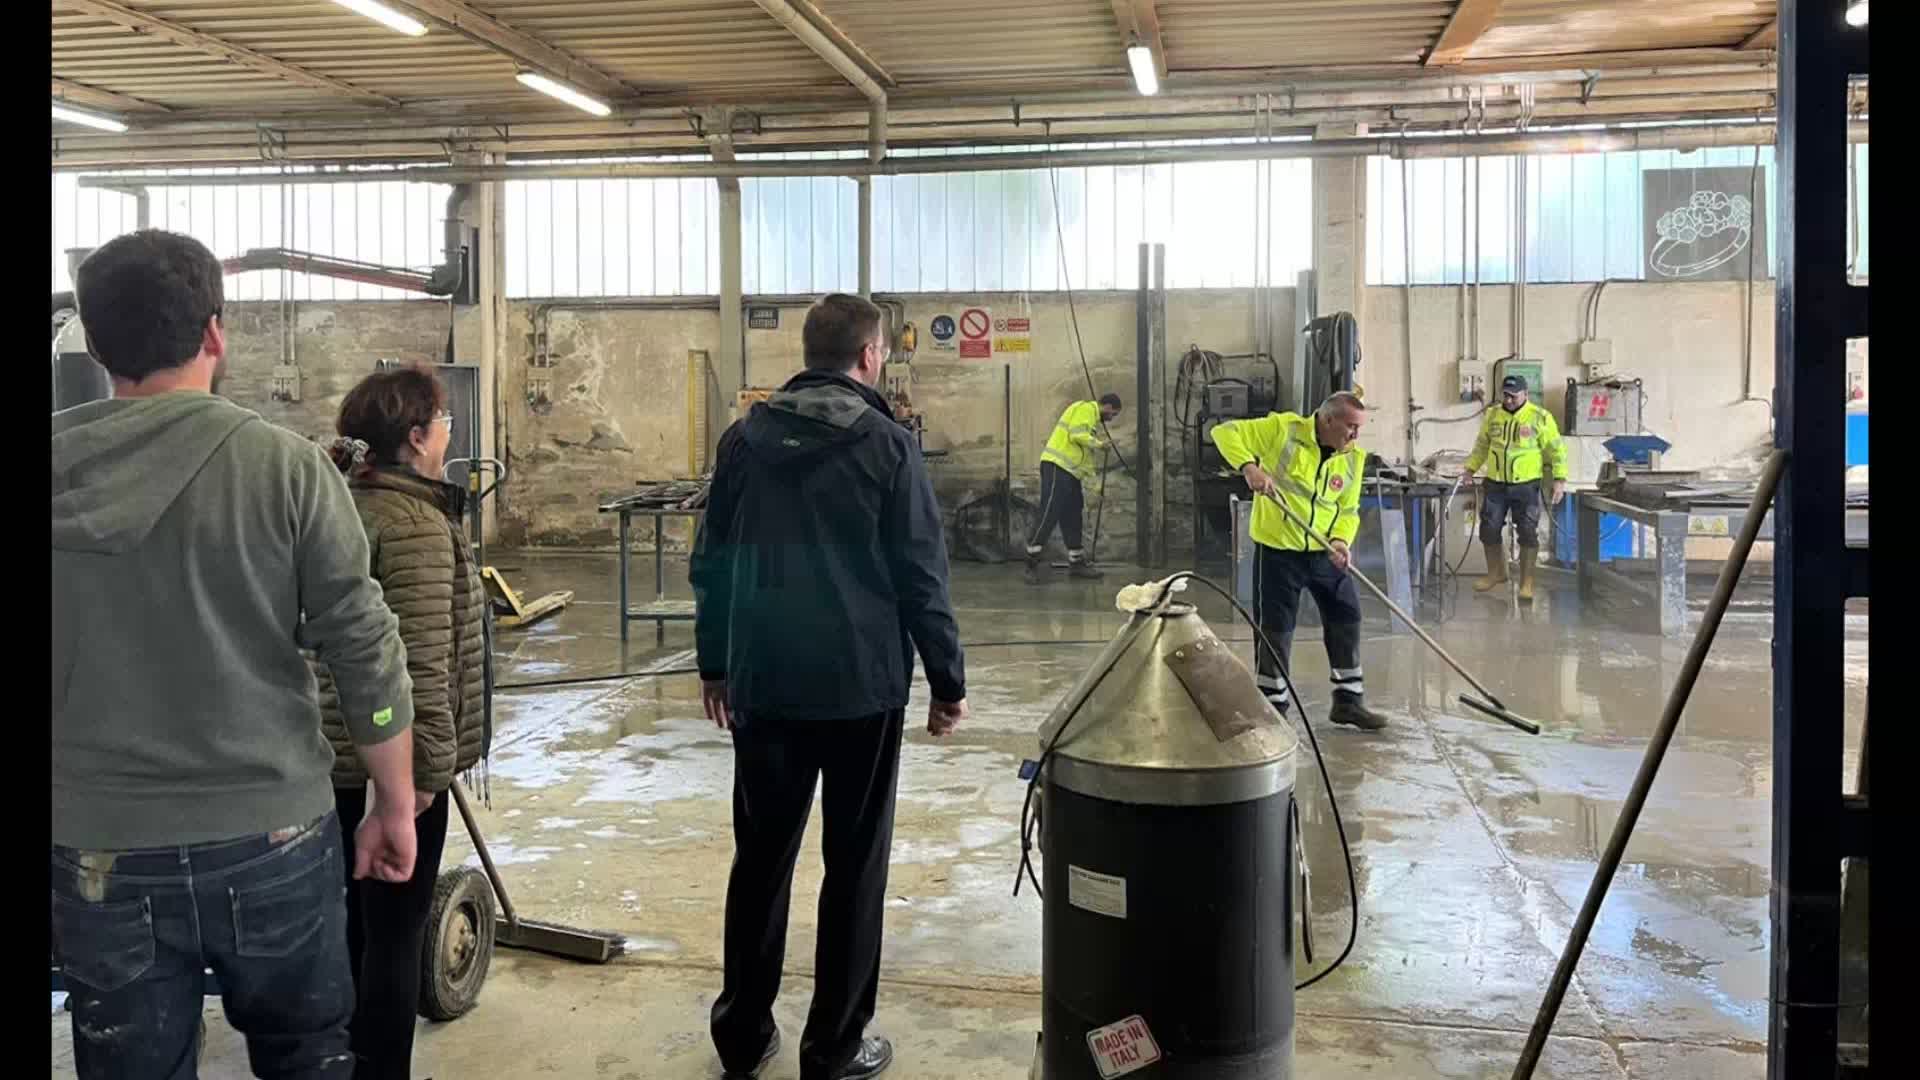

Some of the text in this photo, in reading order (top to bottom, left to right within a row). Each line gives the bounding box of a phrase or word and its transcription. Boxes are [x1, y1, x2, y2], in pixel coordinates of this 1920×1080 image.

[1094, 1023, 1144, 1055] MADE IN
[1109, 1043, 1141, 1069] ITALY
